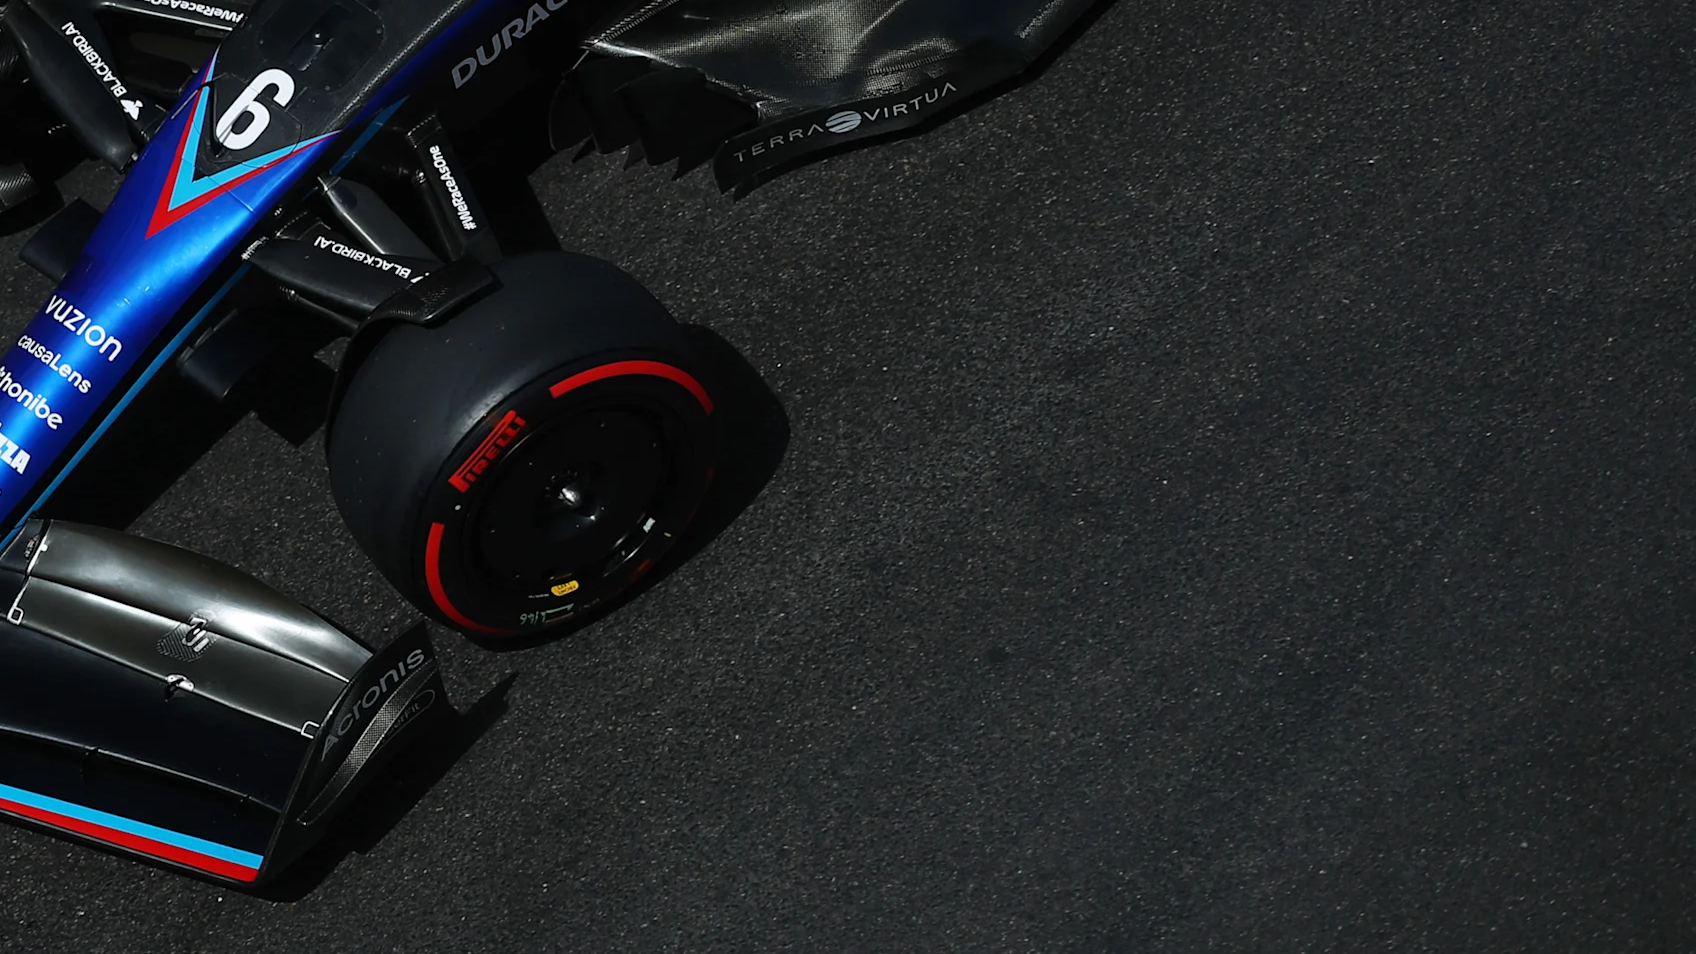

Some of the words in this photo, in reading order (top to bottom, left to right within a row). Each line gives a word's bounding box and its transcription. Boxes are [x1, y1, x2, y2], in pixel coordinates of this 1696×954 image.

[61, 21, 128, 98] BLACKBIRD.AI
[216, 68, 296, 151] 6
[733, 123, 824, 162] TERRA
[863, 82, 957, 122] VIRTUA
[429, 145, 477, 230] #WeRaceAsOne
[314, 236, 412, 279] BLACKBIRD.AI
[0, 372, 64, 430] honibe
[17, 334, 92, 394] causaLens
[448, 409, 527, 494] PIRELLI
